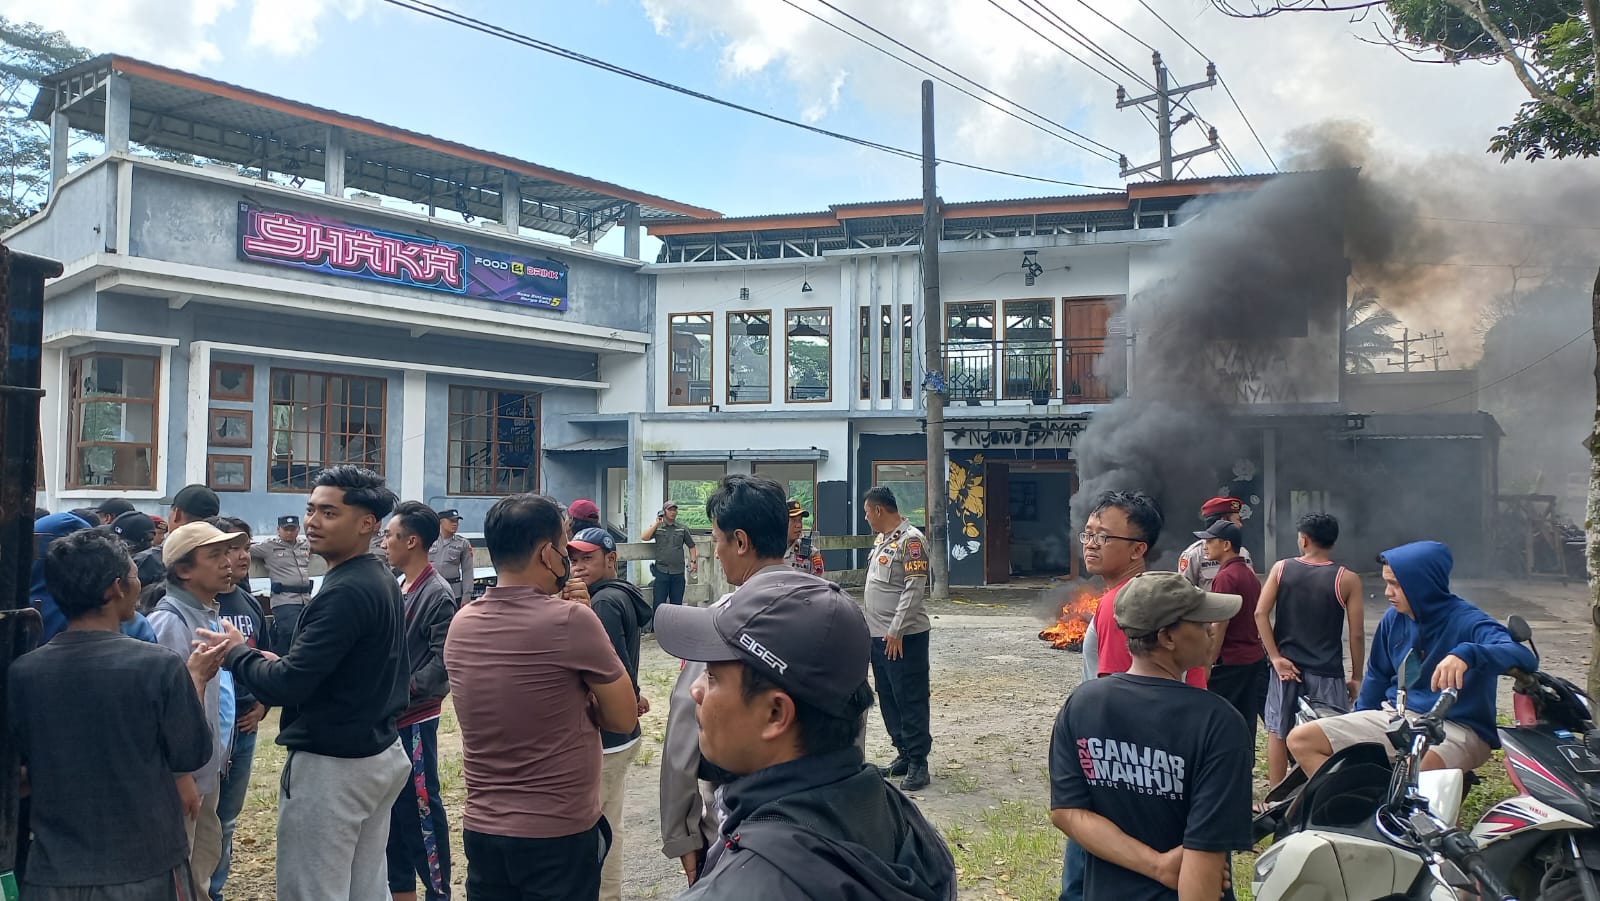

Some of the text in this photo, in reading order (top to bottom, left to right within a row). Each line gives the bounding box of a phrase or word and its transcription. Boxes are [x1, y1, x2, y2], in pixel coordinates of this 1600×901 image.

[245, 213, 464, 285] SHAKA
[474, 257, 508, 270] FOOD
[527, 266, 558, 279] DRINK
[550, 297, 561, 307] 5
[740, 633, 788, 675] EIGER
[1076, 738, 1096, 779] 2024
[1087, 737, 1185, 780] GANJAR
[1529, 805, 1548, 818] YAMAHA
